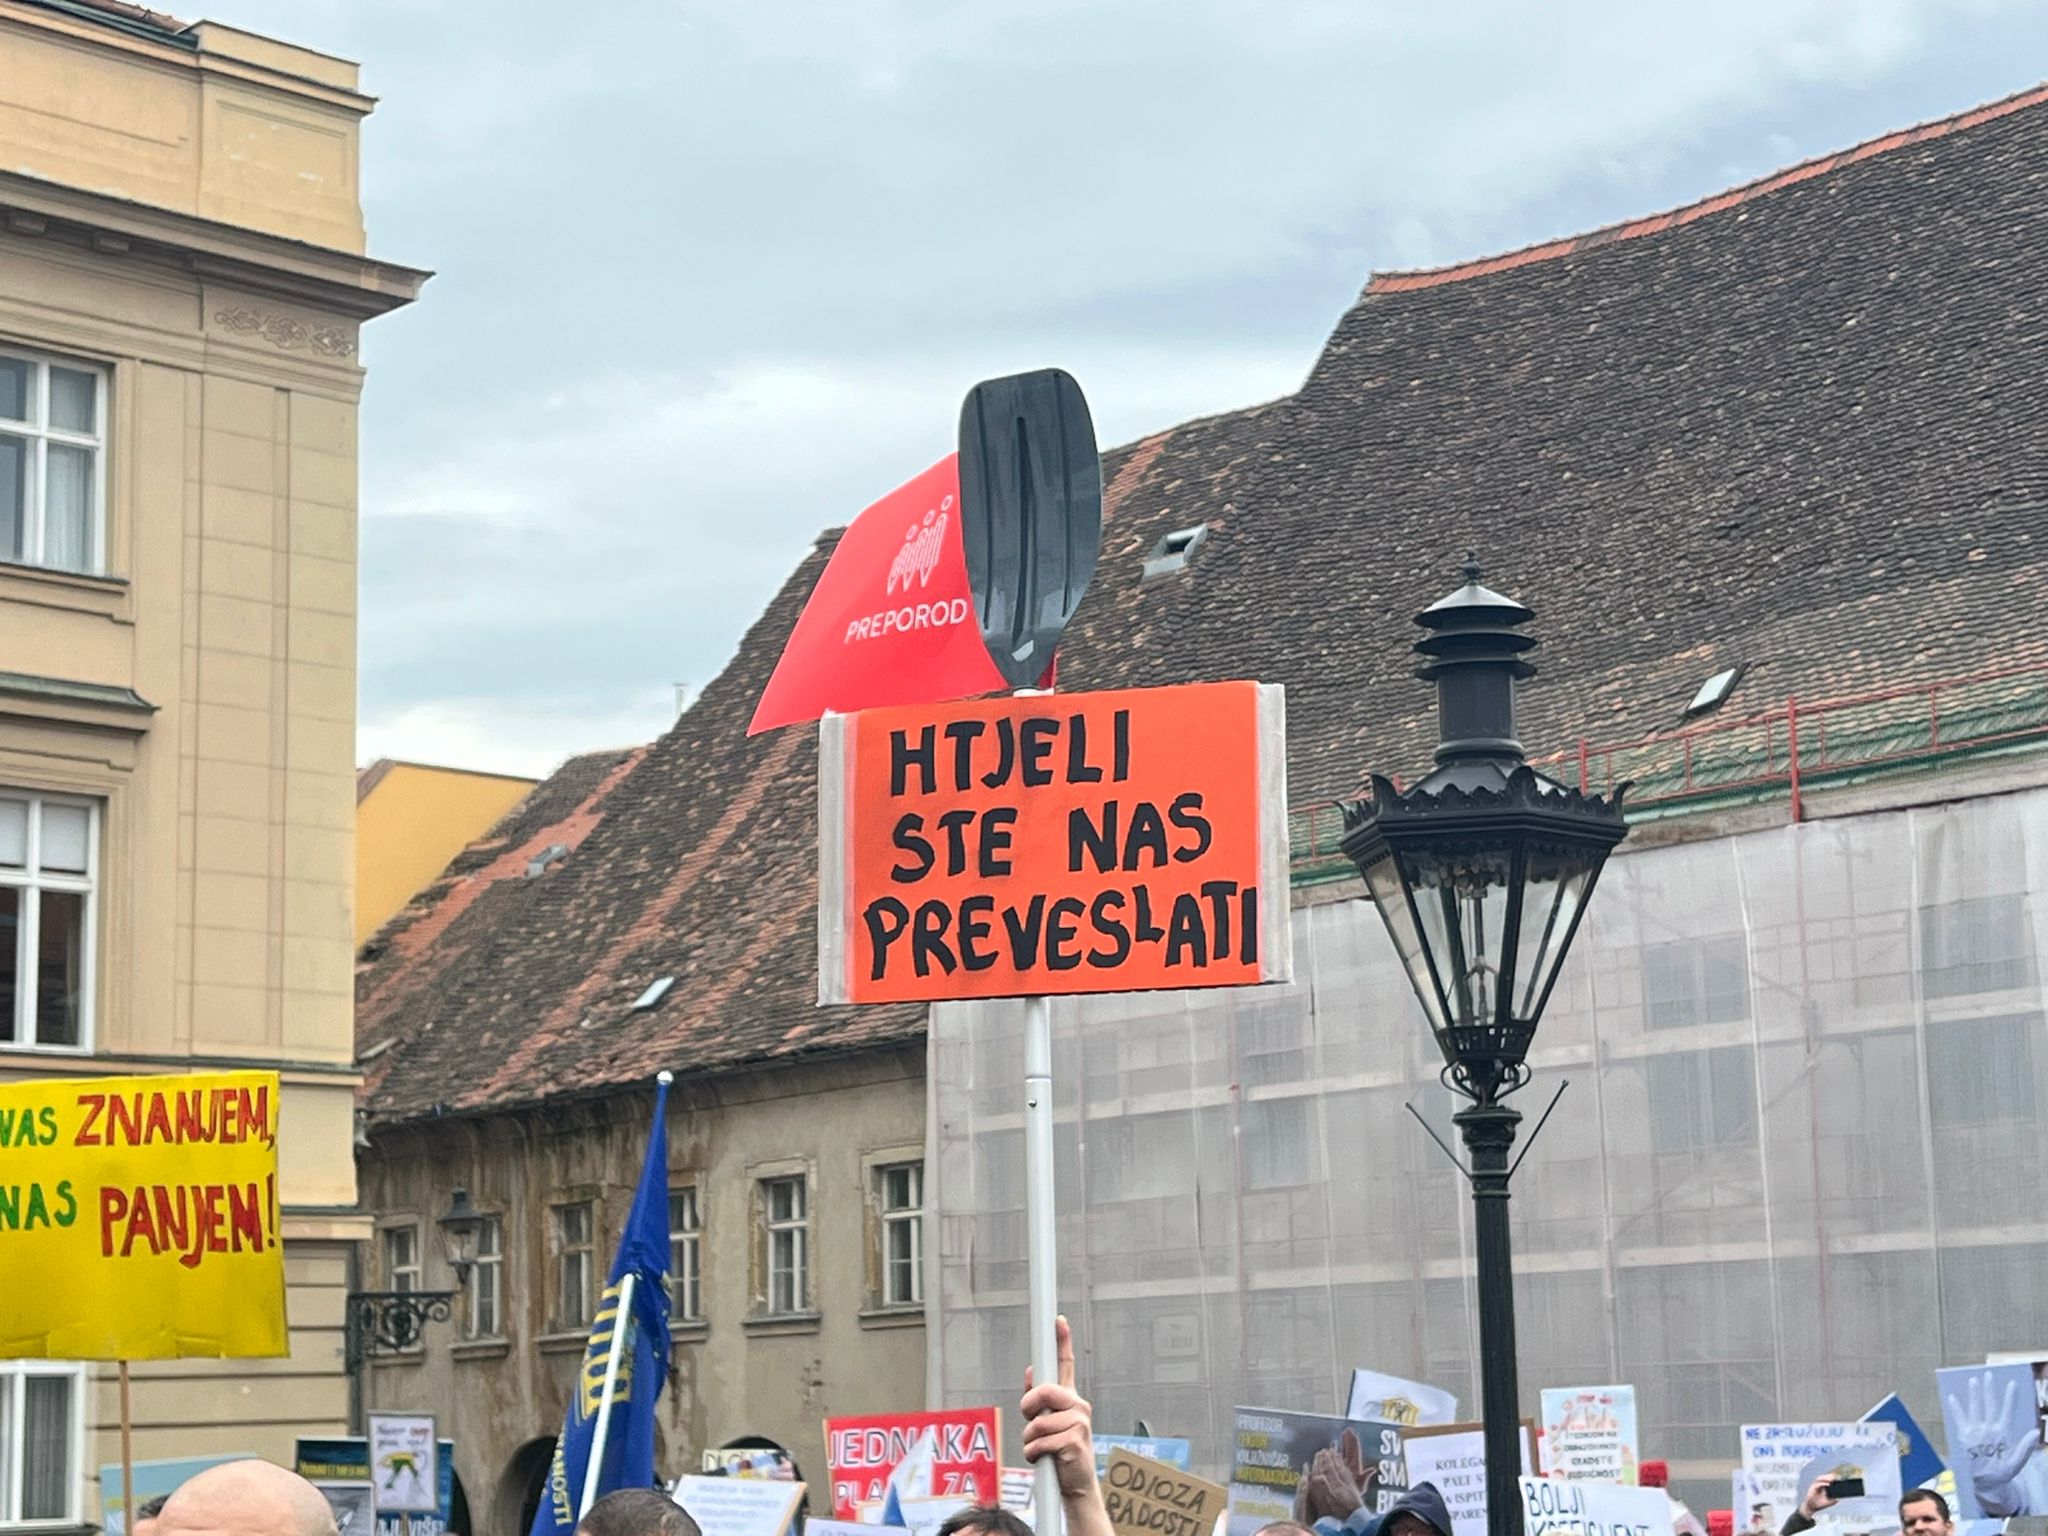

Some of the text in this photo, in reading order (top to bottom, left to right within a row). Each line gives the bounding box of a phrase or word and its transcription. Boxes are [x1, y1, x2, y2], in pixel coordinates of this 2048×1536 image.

[844, 598, 968, 644] PREPOROD
[890, 709, 1130, 797] HTJELI
[891, 793, 1212, 883] STE NAS
[863, 881, 1258, 981] PREVESLATI
[75, 1085, 276, 1151] ZNANJEM,
[0, 1180, 78, 1232] NAS
[1968, 1442, 2009, 1461] STOP
[1525, 1482, 1586, 1517] BOLJI
